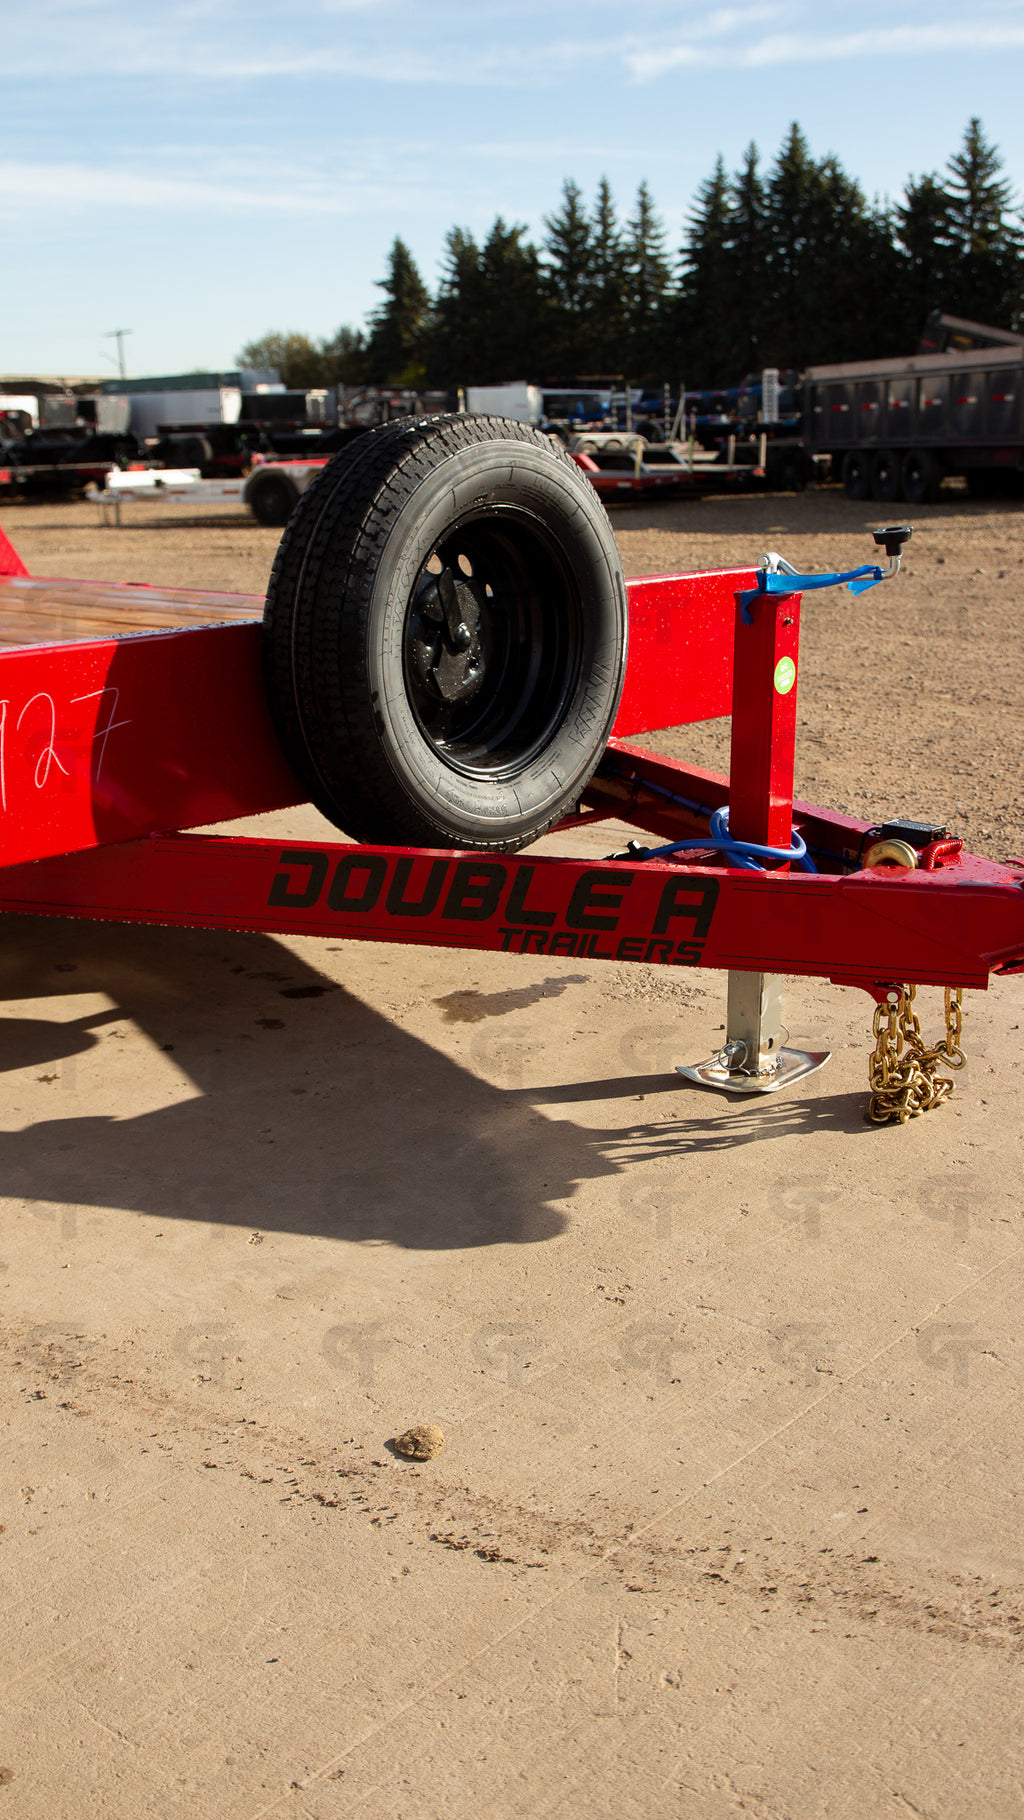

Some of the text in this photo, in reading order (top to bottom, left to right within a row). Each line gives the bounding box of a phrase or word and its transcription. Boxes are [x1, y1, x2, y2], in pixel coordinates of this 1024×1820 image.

[267, 851, 720, 938] DOUBLE A
[497, 927, 707, 966] TRAILERS
